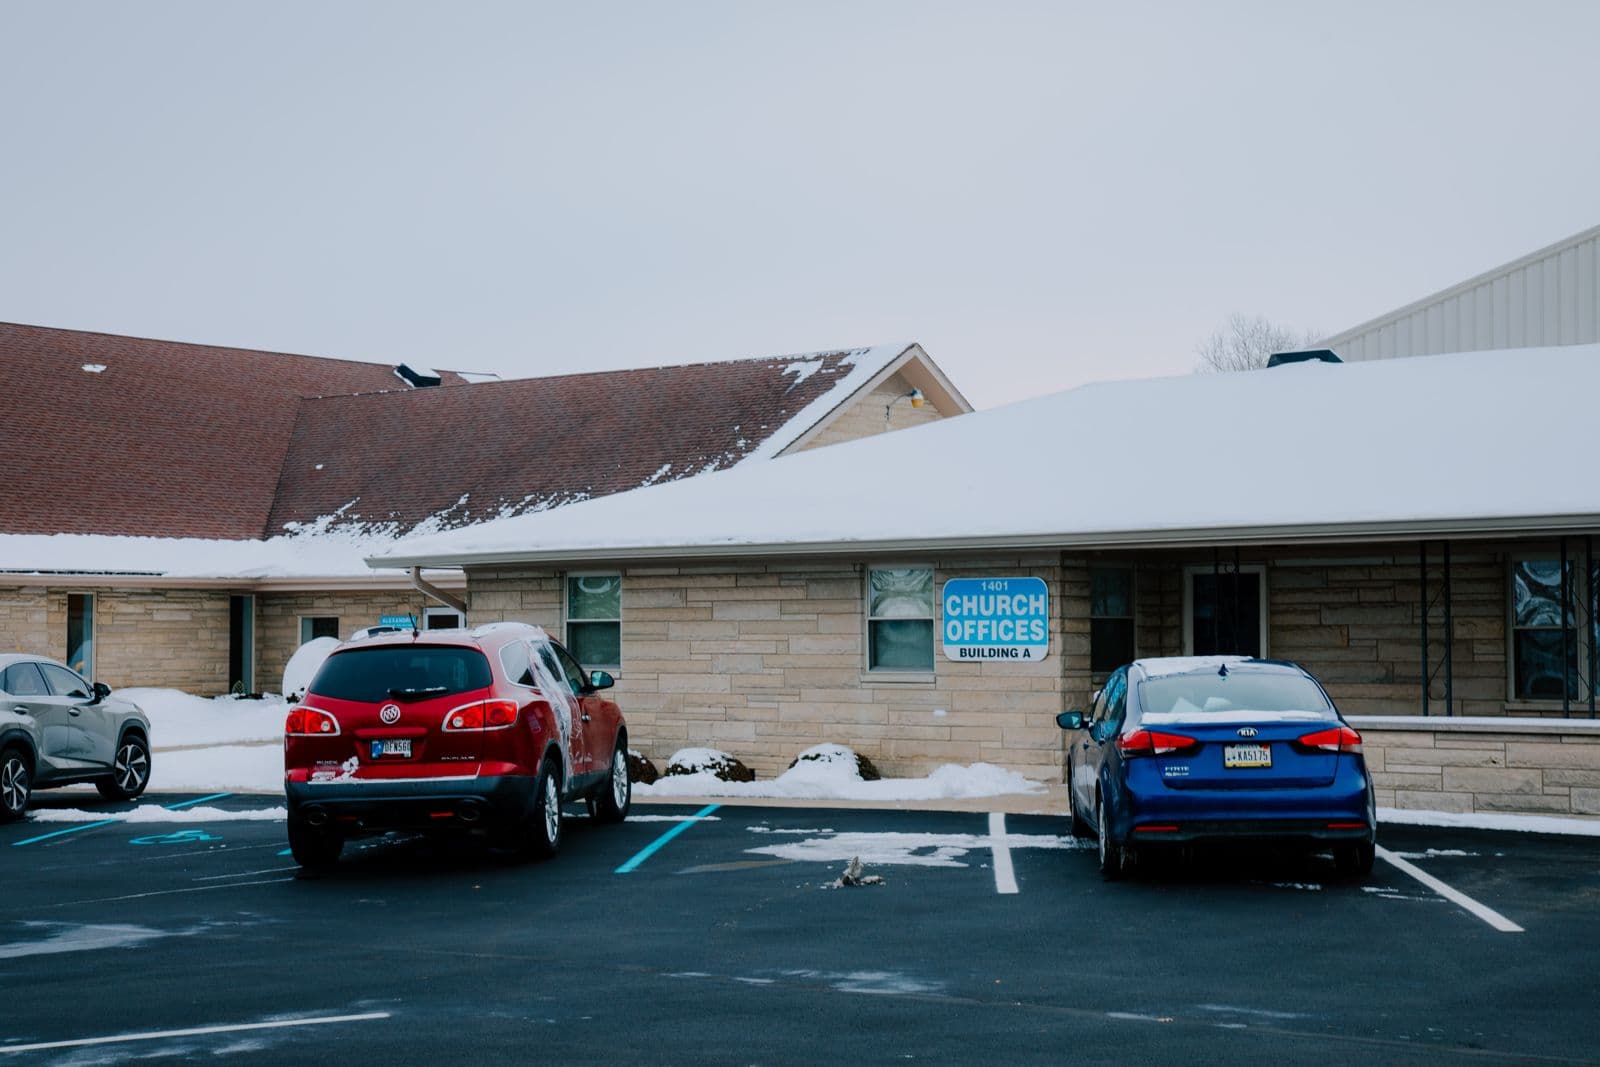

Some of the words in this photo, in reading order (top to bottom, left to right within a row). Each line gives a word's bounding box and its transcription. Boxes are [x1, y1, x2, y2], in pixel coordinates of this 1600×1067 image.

[981, 580, 1009, 591] 1401
[946, 594, 1045, 617] CHURCH
[946, 619, 1044, 641] OFFICES
[960, 647, 1018, 658] BUILDING
[1023, 647, 1031, 658] A
[1237, 750, 1268, 761] KA5175
